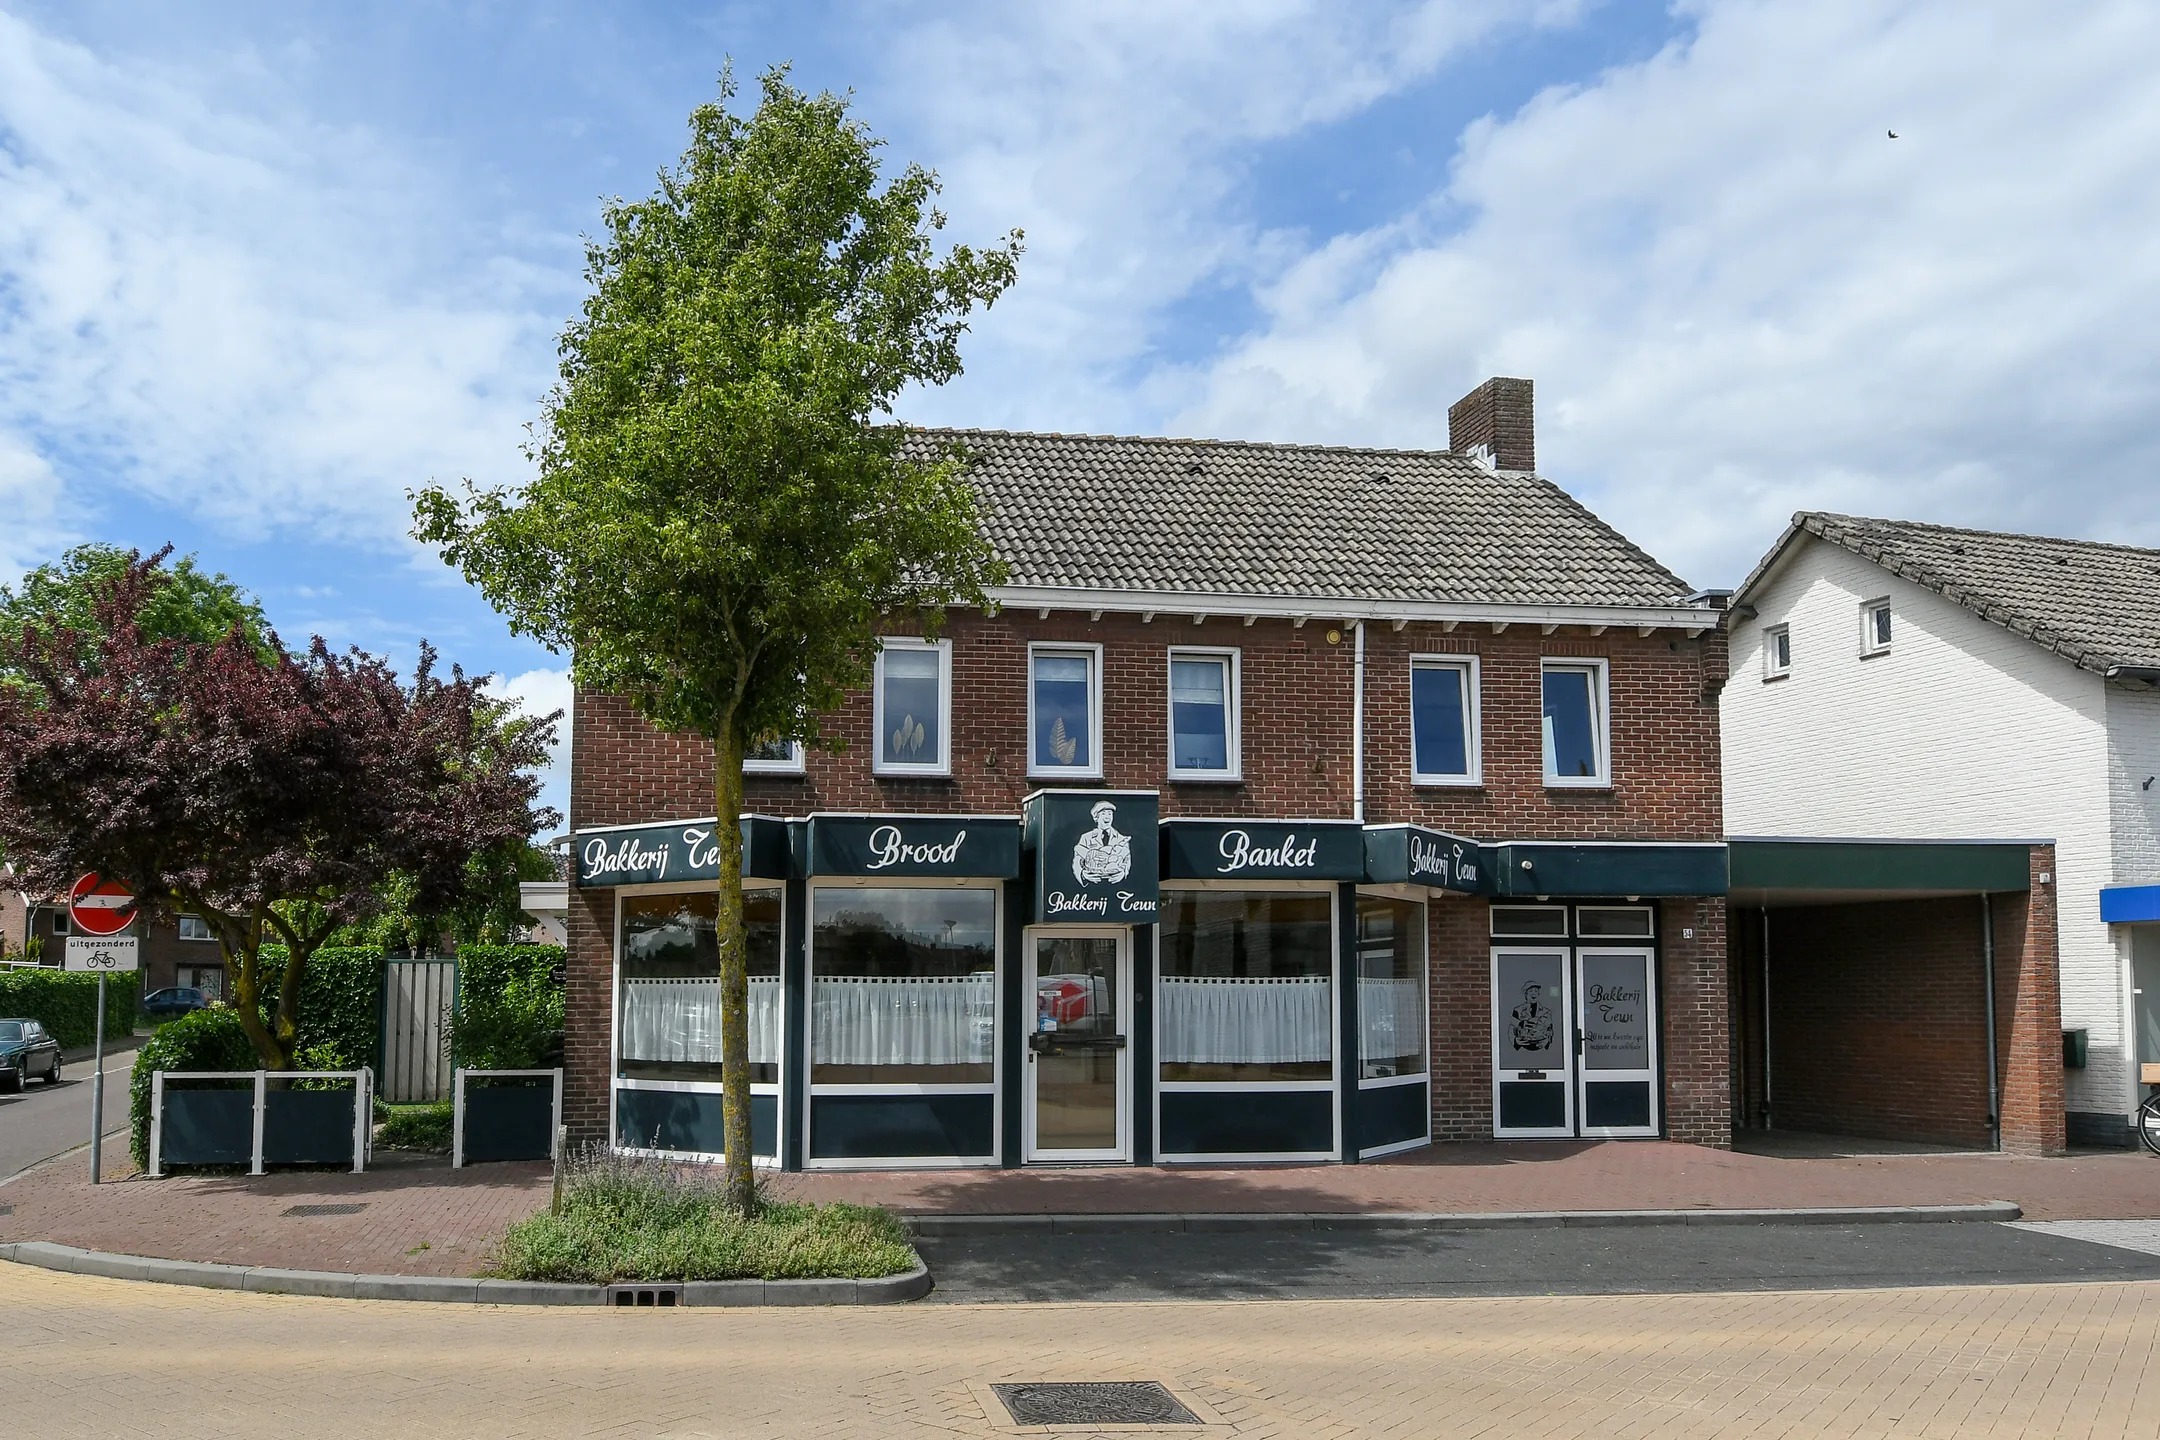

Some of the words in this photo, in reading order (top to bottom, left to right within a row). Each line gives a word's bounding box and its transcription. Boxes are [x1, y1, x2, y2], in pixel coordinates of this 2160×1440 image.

[582, 838, 669, 879] Bakkerij
[682, 828, 743, 869] Te
[866, 825, 966, 869] Brood
[1217, 830, 1317, 873] Banket
[1410, 835, 1449, 886] Bakkerij
[1452, 843, 1477, 881] Teun
[1047, 891, 1108, 916] Bakkerij
[1116, 890, 1157, 912] Teun
[70, 940, 135, 949] uitgezonderd
[1589, 984, 1640, 1006] Bakkerij
[1598, 1004, 1634, 1023] Teun
